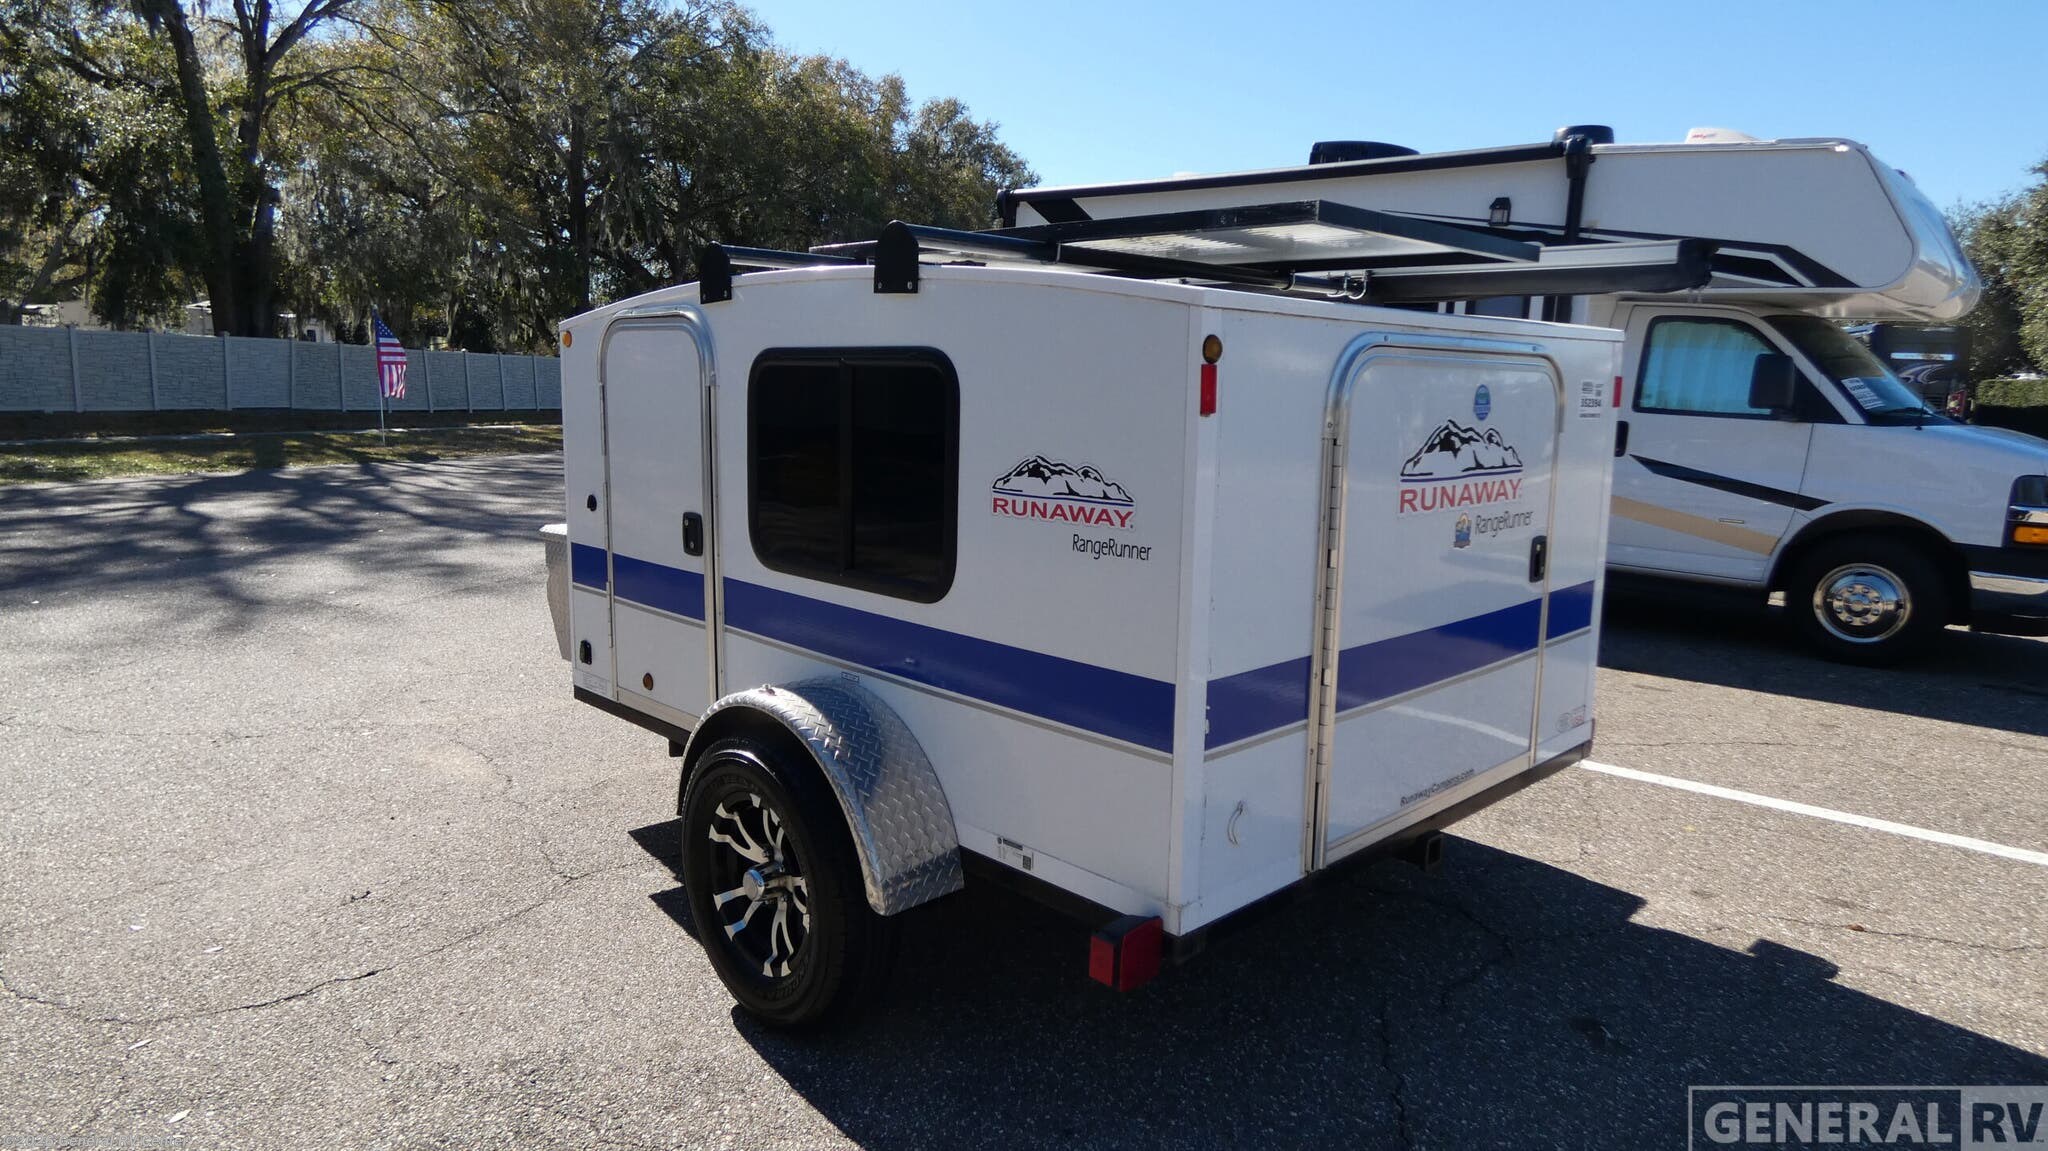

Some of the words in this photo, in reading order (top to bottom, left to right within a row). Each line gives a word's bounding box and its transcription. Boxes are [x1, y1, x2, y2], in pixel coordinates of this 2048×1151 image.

[1400, 478, 1522, 513] RUNAWAY
[992, 497, 1133, 528] RUNAWAY
[1475, 510, 1534, 538] RangeRunner
[1072, 534, 1152, 560] RangeRunner
